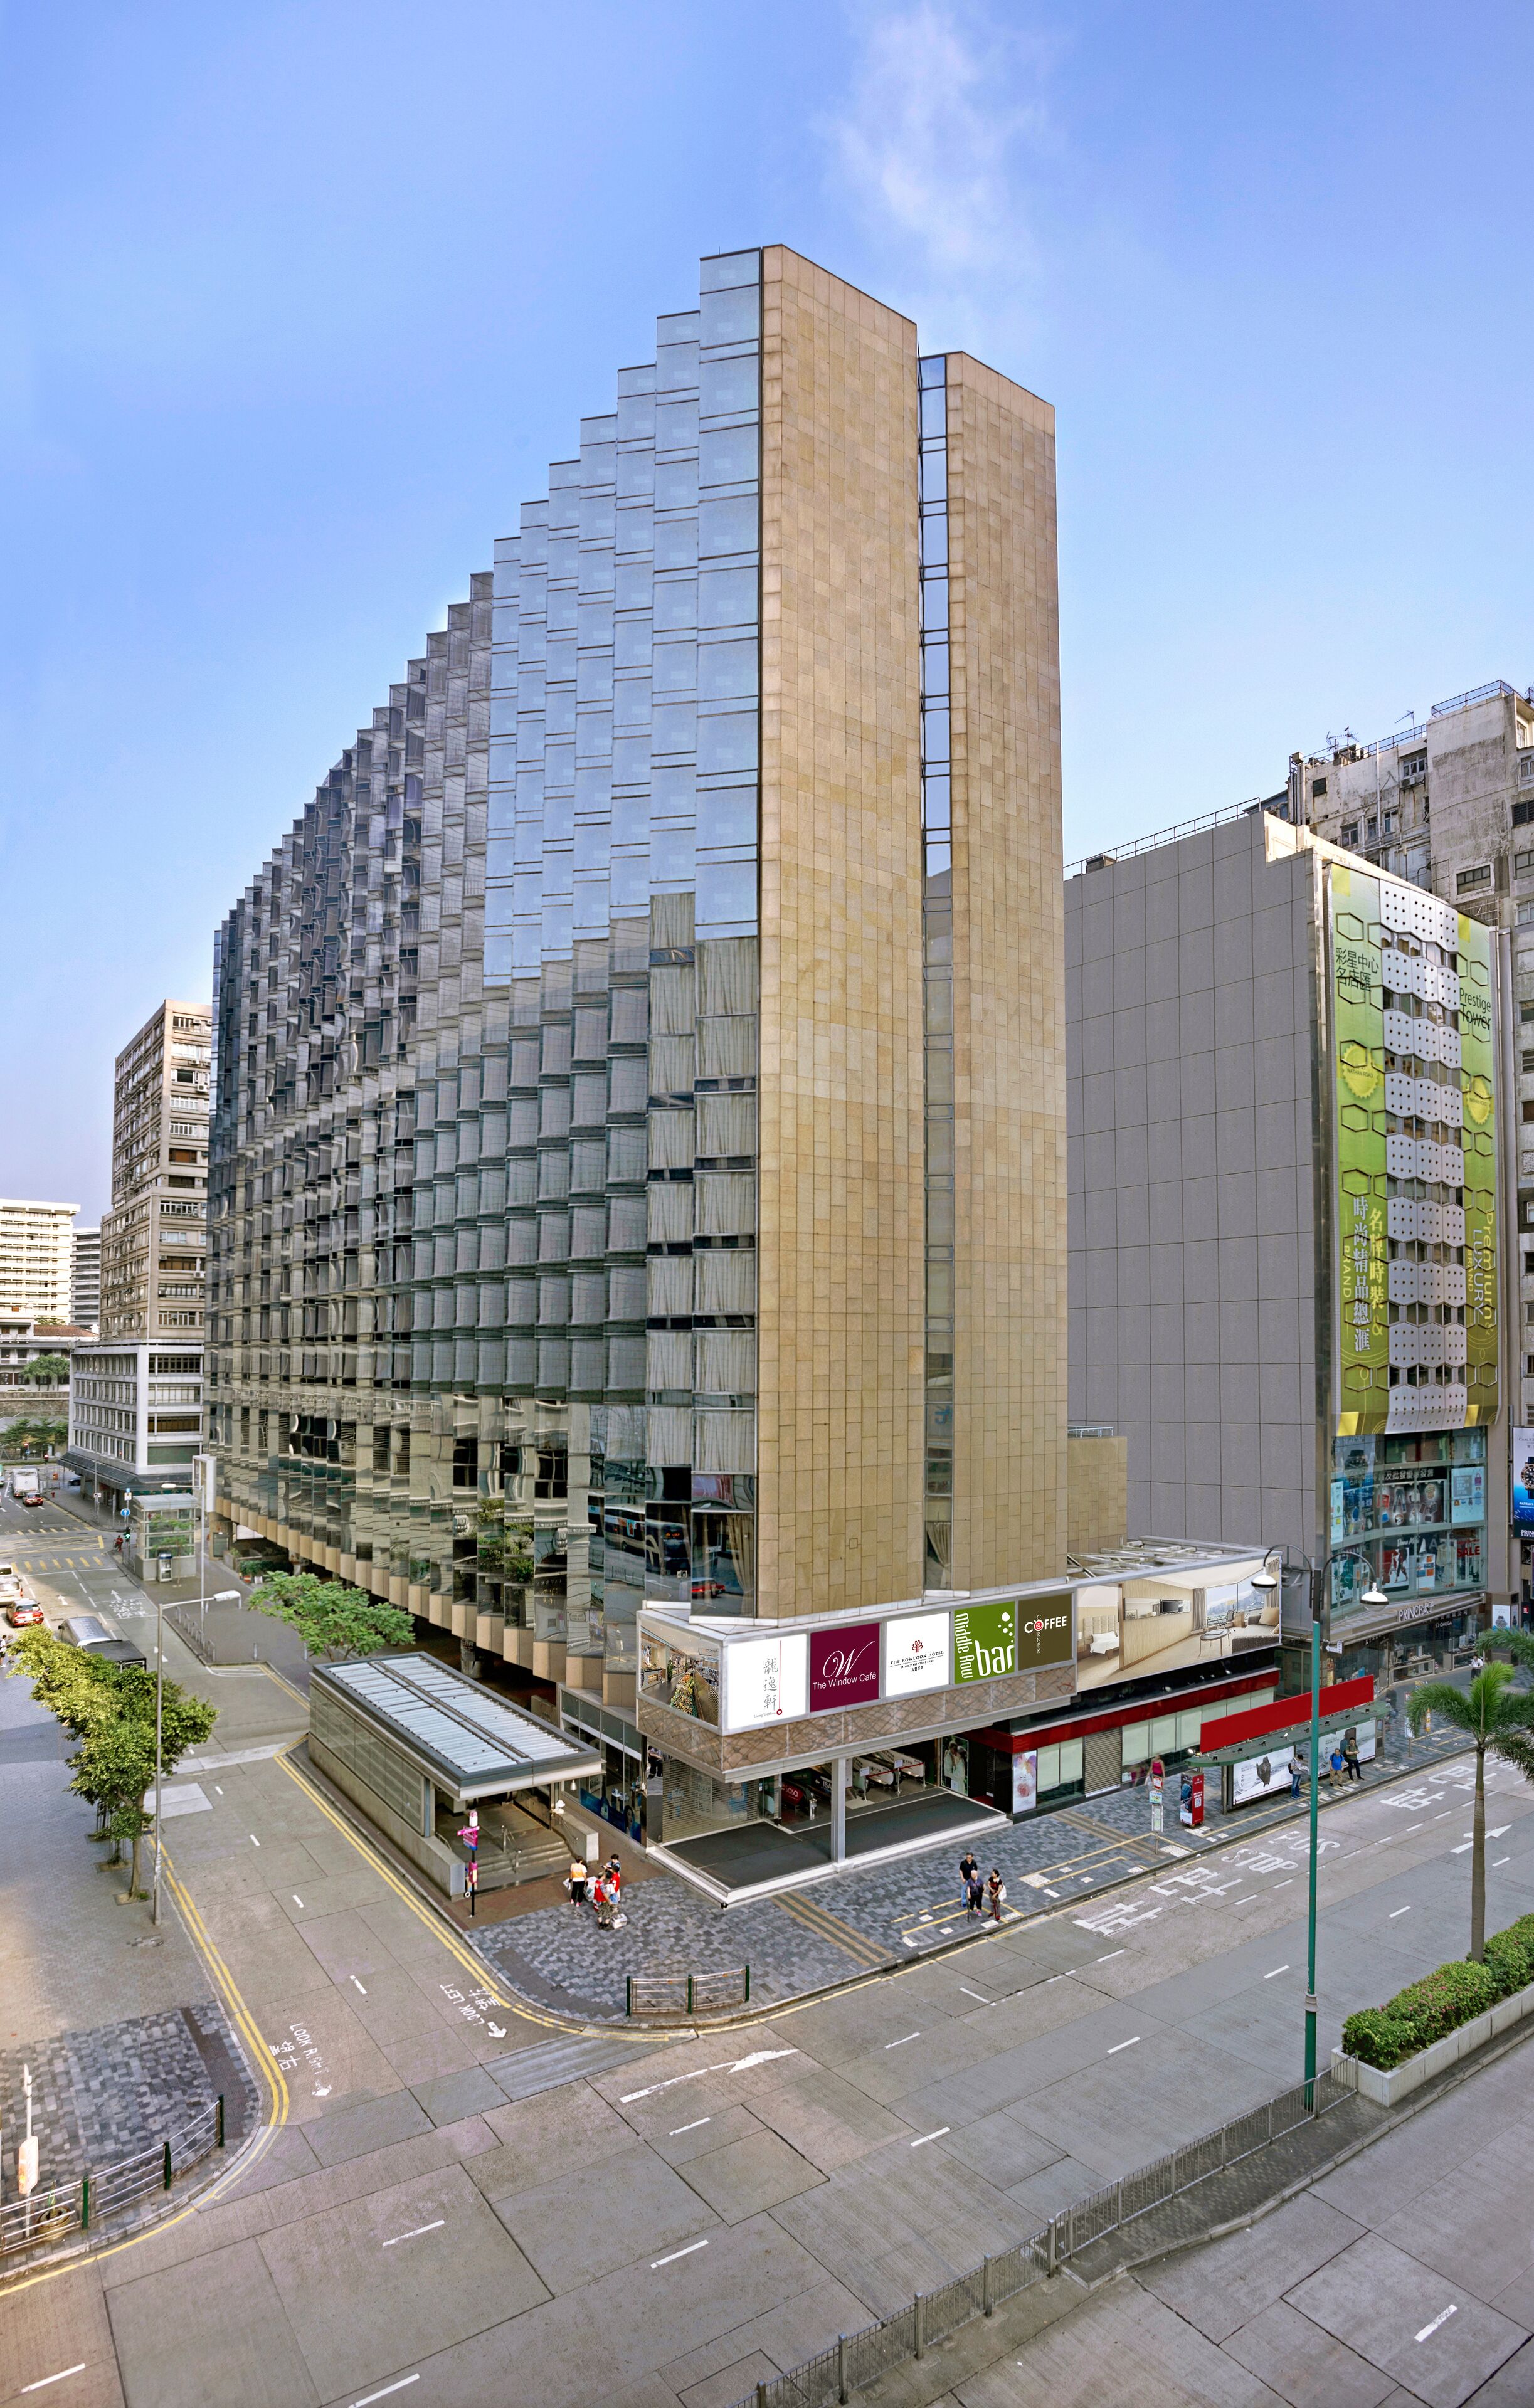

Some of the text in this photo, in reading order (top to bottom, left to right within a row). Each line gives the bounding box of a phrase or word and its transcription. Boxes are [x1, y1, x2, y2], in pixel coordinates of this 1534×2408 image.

[1336, 948, 1379, 974] 彩星中心
[1336, 966, 1372, 991] 名店匯
[1459, 988, 1491, 1014] Prestige
[1461, 1003, 1491, 1030] Tower
[1343, 1245, 1352, 1297] BRAND
[1369, 1208, 1385, 1309] 名牌時裝
[1473, 1229, 1484, 1316] LUXURY
[1457, 1546, 1480, 1558] SALE
[1024, 1615, 1067, 1634] COFFEE
[902, 1654, 926, 1662] KOWLOON
[955, 1613, 975, 1679] Middle Row
[975, 1640, 1015, 1676] bar
[763, 1657, 778, 1711] 龍逸軒
[813, 1672, 877, 1690] The Window Café
[1380, 1787, 1446, 1811] 站
[1221, 1848, 1298, 1874] STOP
[1072, 1899, 1163, 1936] 站
[440, 1983, 485, 2026] LOOK LEFT
[290, 2022, 313, 2047] LOOK
